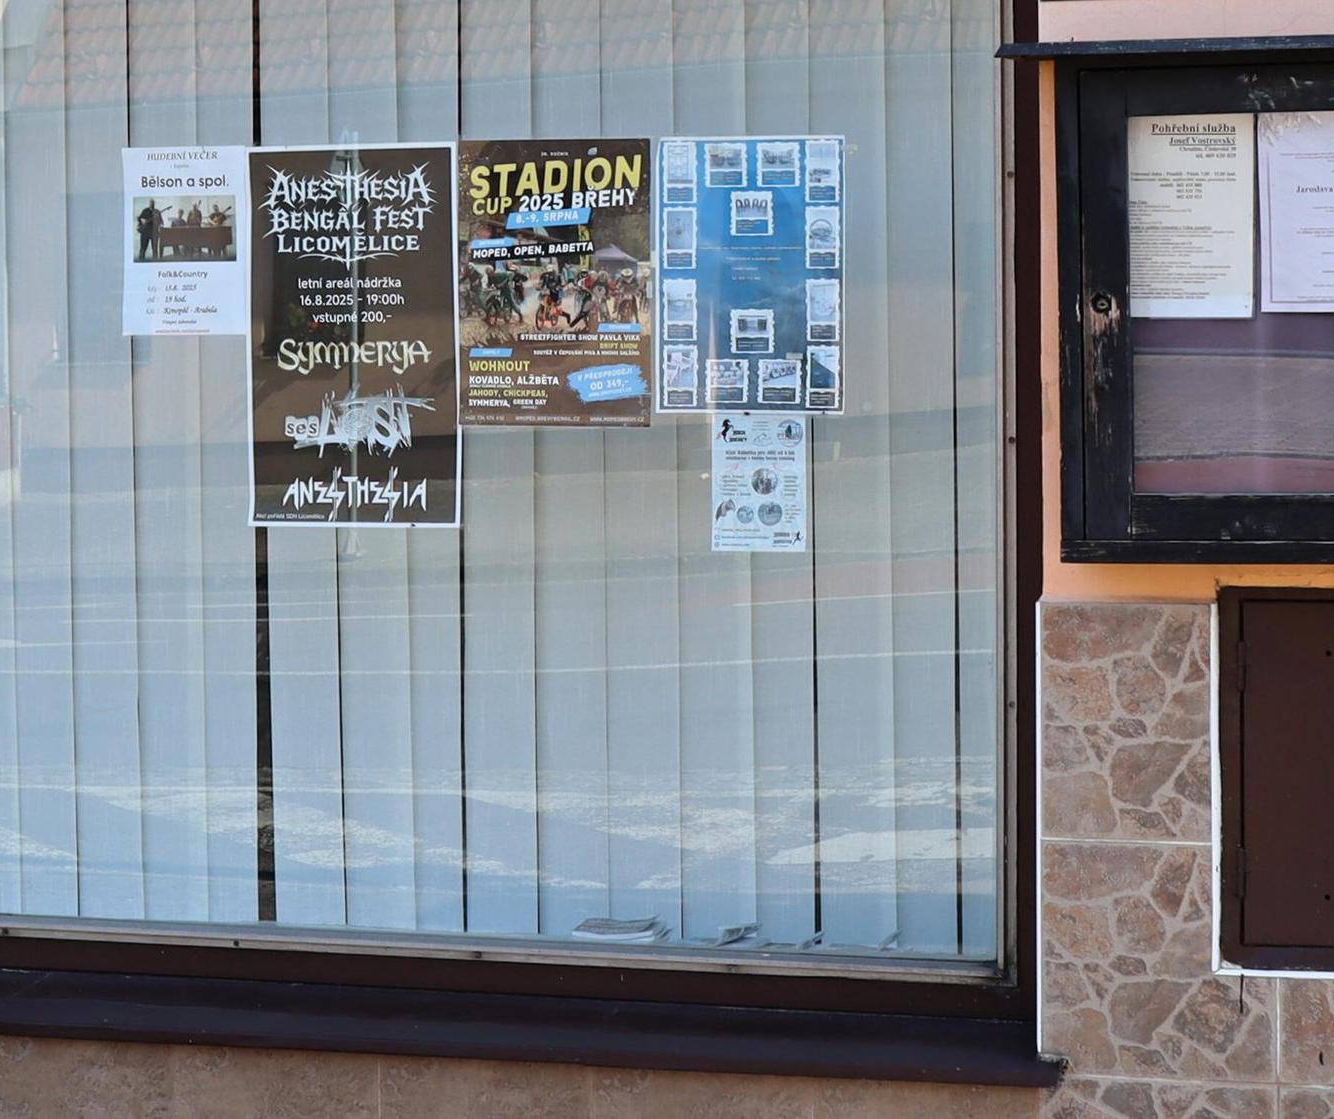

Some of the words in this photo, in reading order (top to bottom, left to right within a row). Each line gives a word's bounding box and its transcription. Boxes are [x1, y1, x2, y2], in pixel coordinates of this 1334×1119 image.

[1152, 123, 1199, 133] Pohřební
[1203, 123, 1236, 133] služba
[141, 176, 182, 188] Bělson
[187, 179, 195, 187] a
[199, 175, 229, 188] spol.
[469, 154, 642, 199] STADION
[472, 197, 512, 215] CUP
[519, 192, 564, 212] 2025
[572, 186, 636, 208] BŘEHY
[373, 202, 434, 234] FEST
[277, 232, 420, 261] LICOMĚLICE
[473, 248, 511, 259] MOPED,
[514, 245, 545, 255] OPEN,
[548, 242, 594, 253] BABETTA
[298, 277, 322, 289] letní
[326, 277, 354, 288] areál
[357, 277, 402, 288] nádržka
[300, 295, 354, 306] 16.8.2025
[366, 294, 405, 305] 19:00h
[313, 311, 357, 324] vstupné
[469, 360, 530, 372] WOHNOUT
[469, 376, 514, 386] KOVADLO,
[517, 375, 559, 385] ALŽBĚTA
